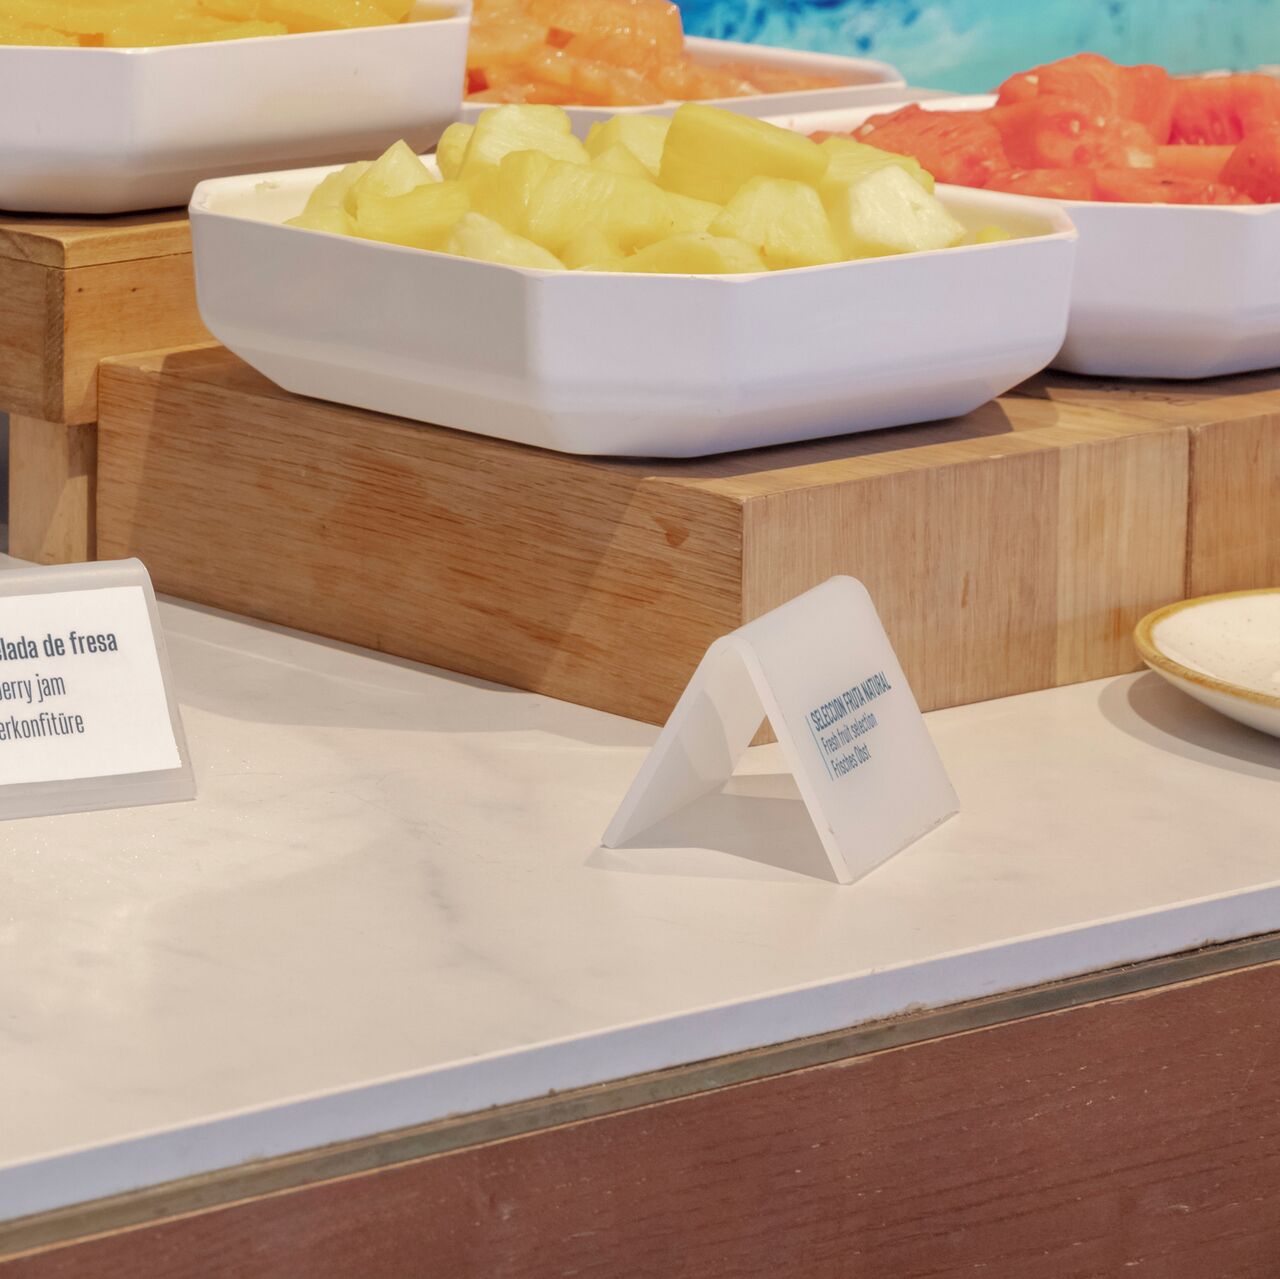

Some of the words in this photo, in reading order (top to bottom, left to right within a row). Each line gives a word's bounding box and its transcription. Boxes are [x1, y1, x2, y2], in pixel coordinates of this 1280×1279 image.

[43, 633, 65, 657] de
[70, 631, 118, 655] fresa
[35, 673, 66, 703] jam
[842, 686, 865, 713] FRUTA
[861, 671, 892, 702] NATURAL
[821, 731, 839, 755] Fresh
[838, 724, 853, 746] fruit
[851, 712, 878, 738] selection
[831, 753, 857, 778] Frisches
[854, 742, 872, 767] Obst
